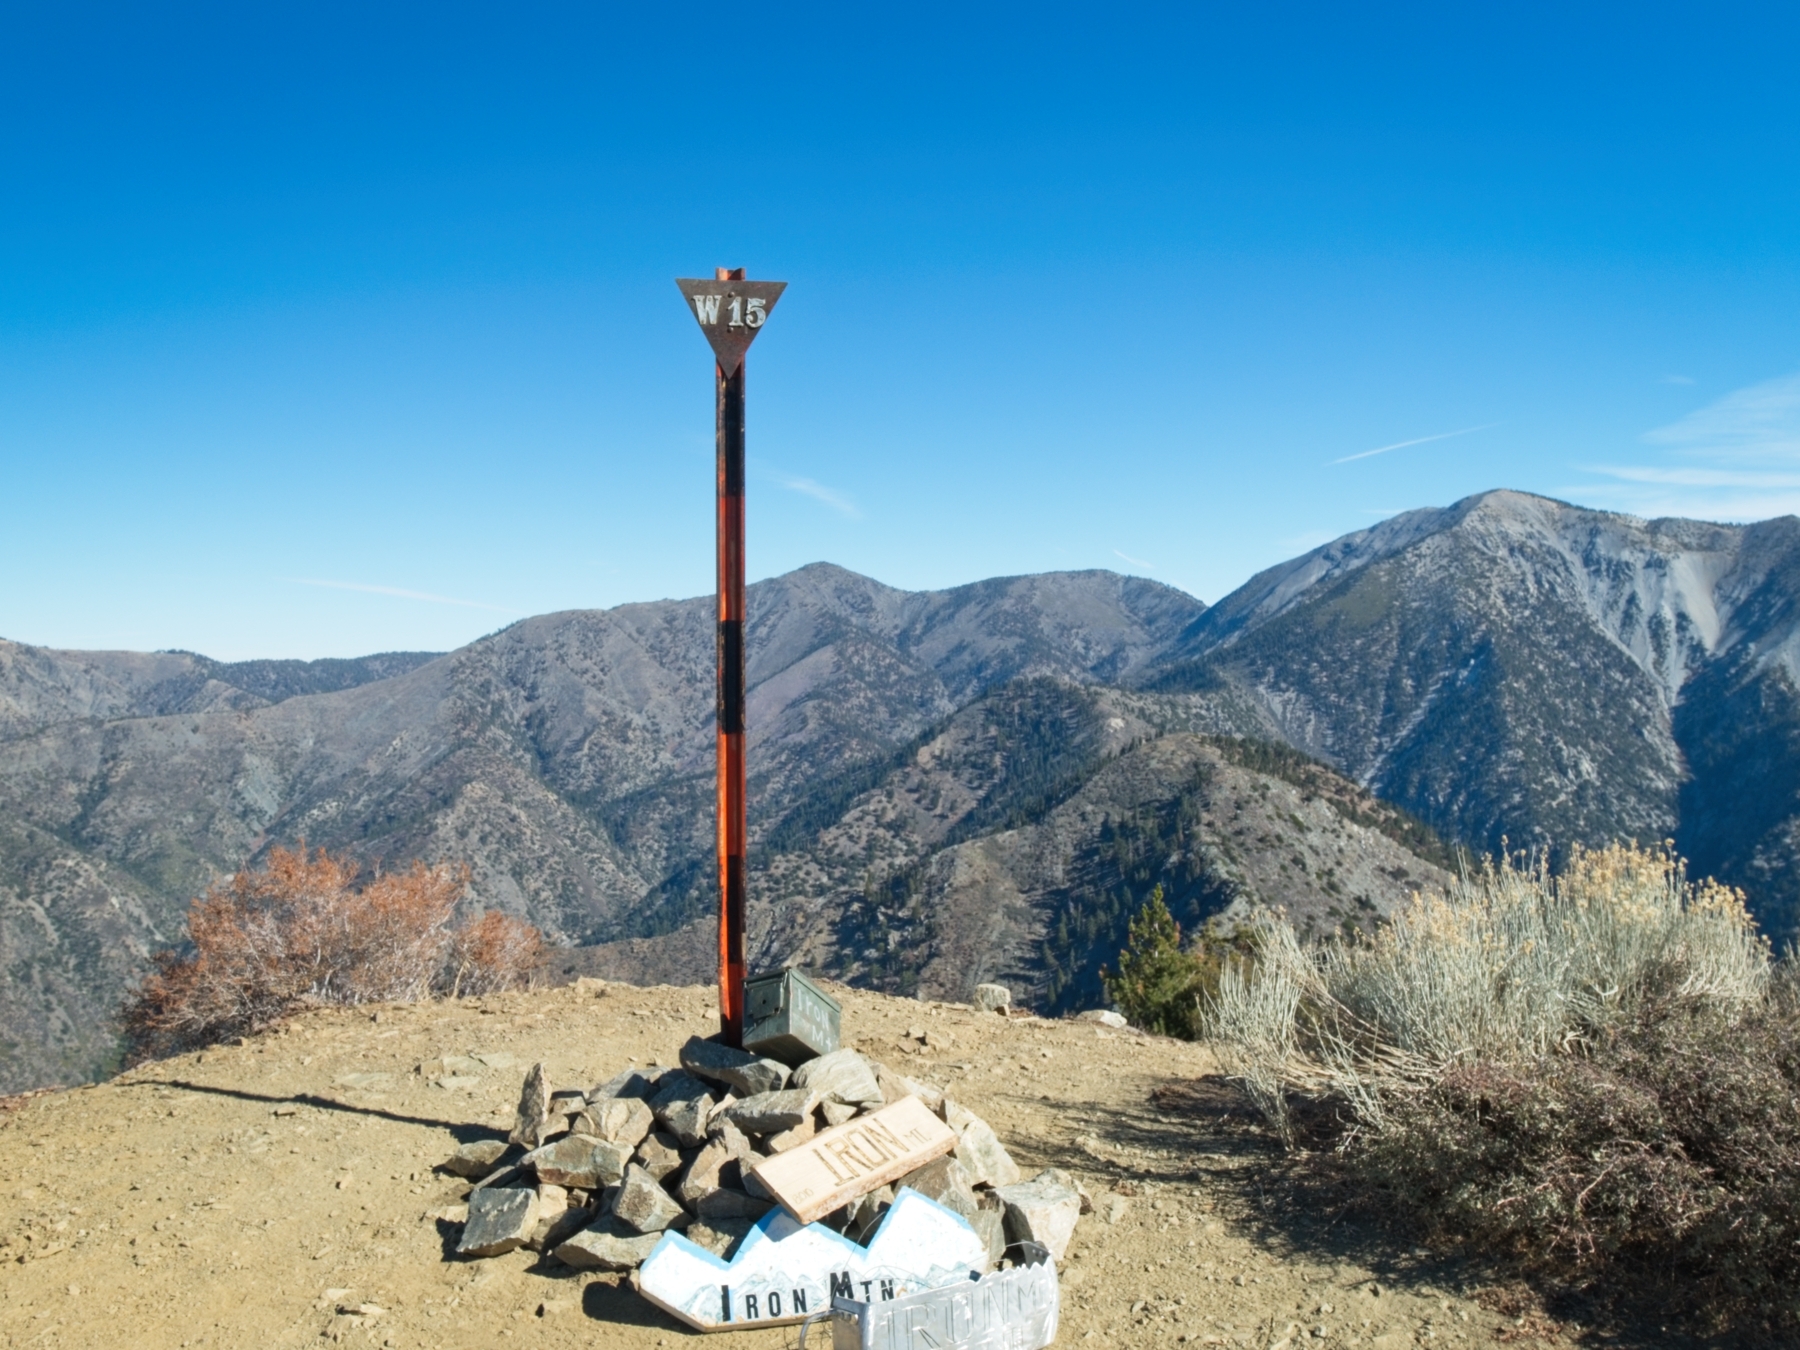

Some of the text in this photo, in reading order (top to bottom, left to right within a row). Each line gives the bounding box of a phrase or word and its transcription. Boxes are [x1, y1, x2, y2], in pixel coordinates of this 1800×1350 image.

[692, 294, 767, 329] W 15
[812, 1117, 910, 1187] IRON
